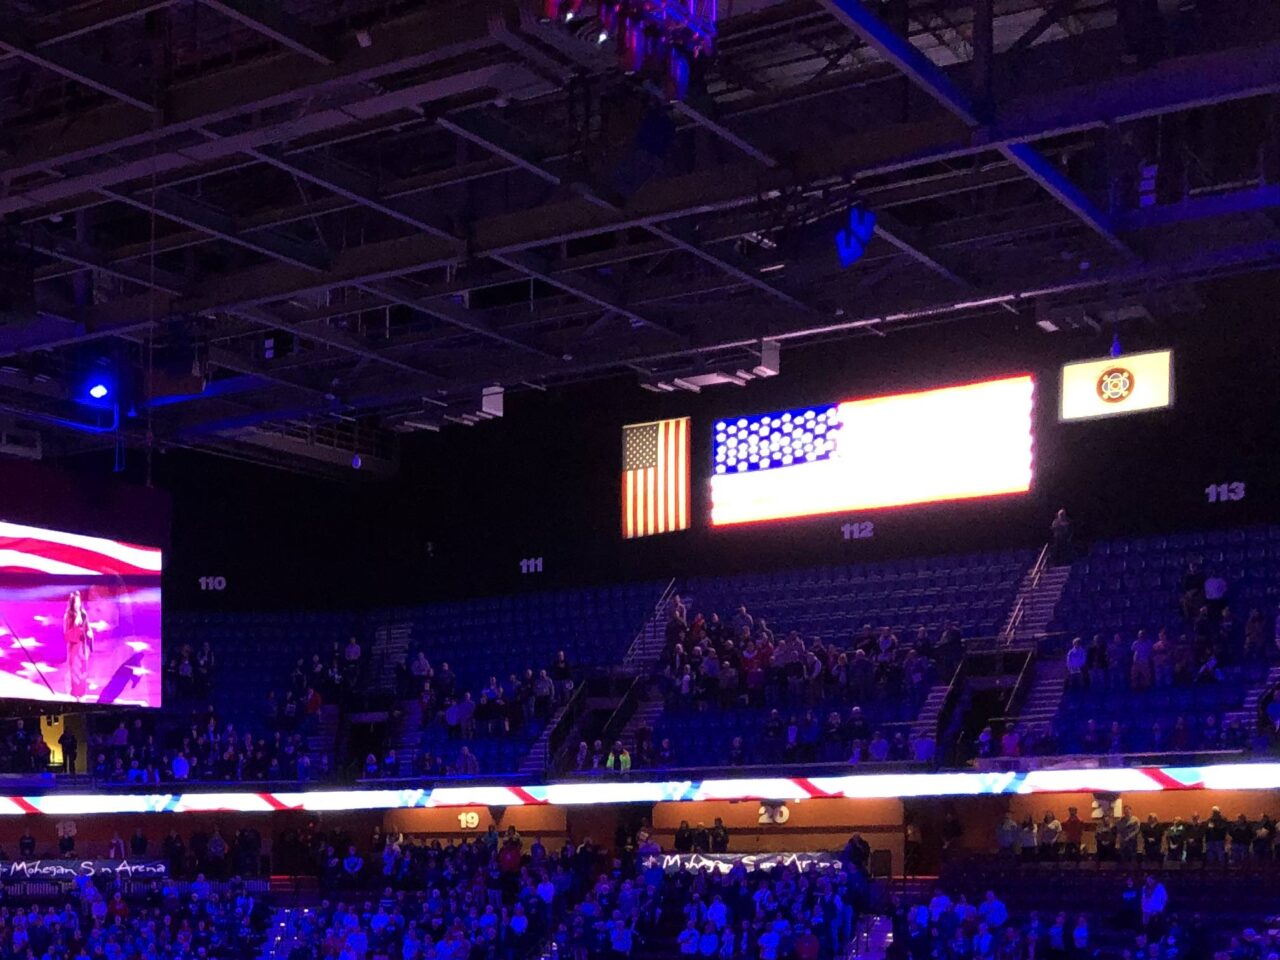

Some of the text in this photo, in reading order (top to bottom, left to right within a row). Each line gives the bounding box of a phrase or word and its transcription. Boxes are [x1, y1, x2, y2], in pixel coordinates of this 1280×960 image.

[1205, 482, 1246, 503] 113
[841, 521, 874, 539] 112
[519, 557, 543, 574] 111
[199, 576, 226, 590] 110
[458, 812, 479, 828] 19
[758, 805, 790, 824] 20
[10, 860, 166, 878] Mohegan Sn Arena
